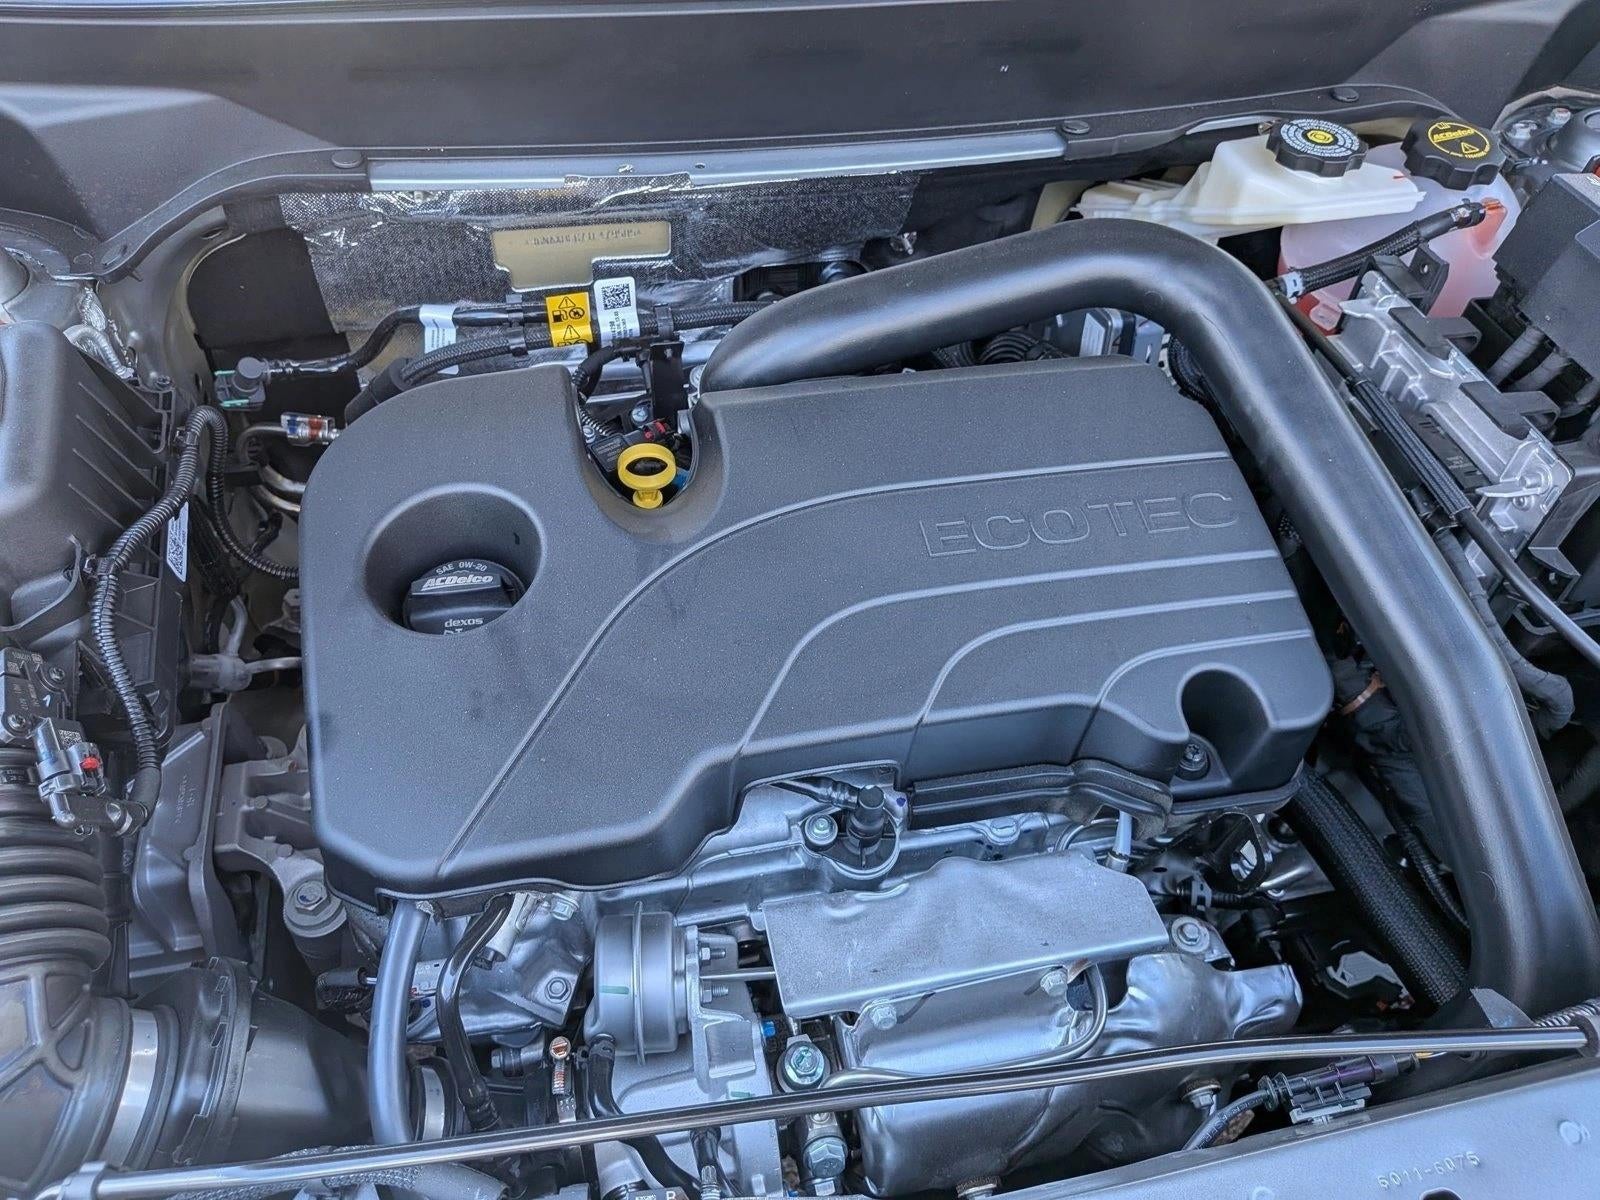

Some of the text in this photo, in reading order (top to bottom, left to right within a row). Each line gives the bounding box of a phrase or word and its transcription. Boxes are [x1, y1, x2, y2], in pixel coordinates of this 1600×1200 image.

[919, 492, 1240, 557] ECOTEC
[436, 561, 488, 575] SAE 0W-20
[421, 574, 494, 590] ACDelco
[444, 617, 484, 628] dexos
